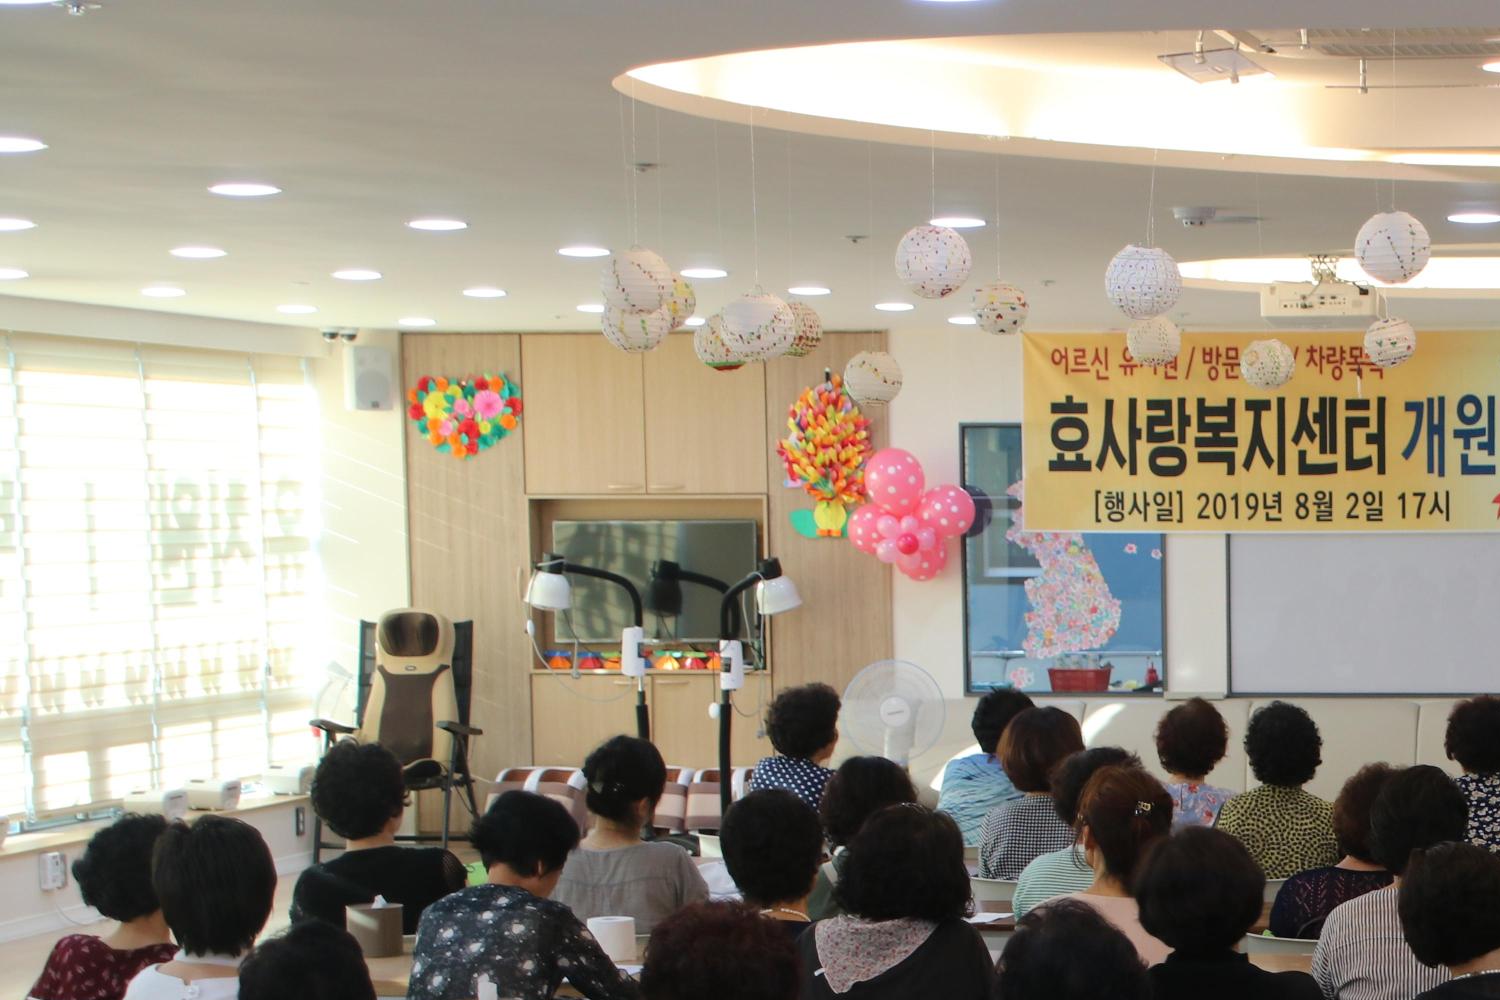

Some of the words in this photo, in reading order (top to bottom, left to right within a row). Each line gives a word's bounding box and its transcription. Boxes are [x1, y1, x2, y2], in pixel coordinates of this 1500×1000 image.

[1051, 346, 1110, 380] 어르신
[1048, 394, 1387, 477] 효사랑복지센터
[1401, 394, 1497, 478] 개원
[1094, 490, 1184, 523] [행사일]
[1196, 491, 1283, 522] 2019년
[1294, 491, 1334, 522] 8월
[1346, 491, 1384, 522] 2일
[1397, 490, 1451, 522] 17시
